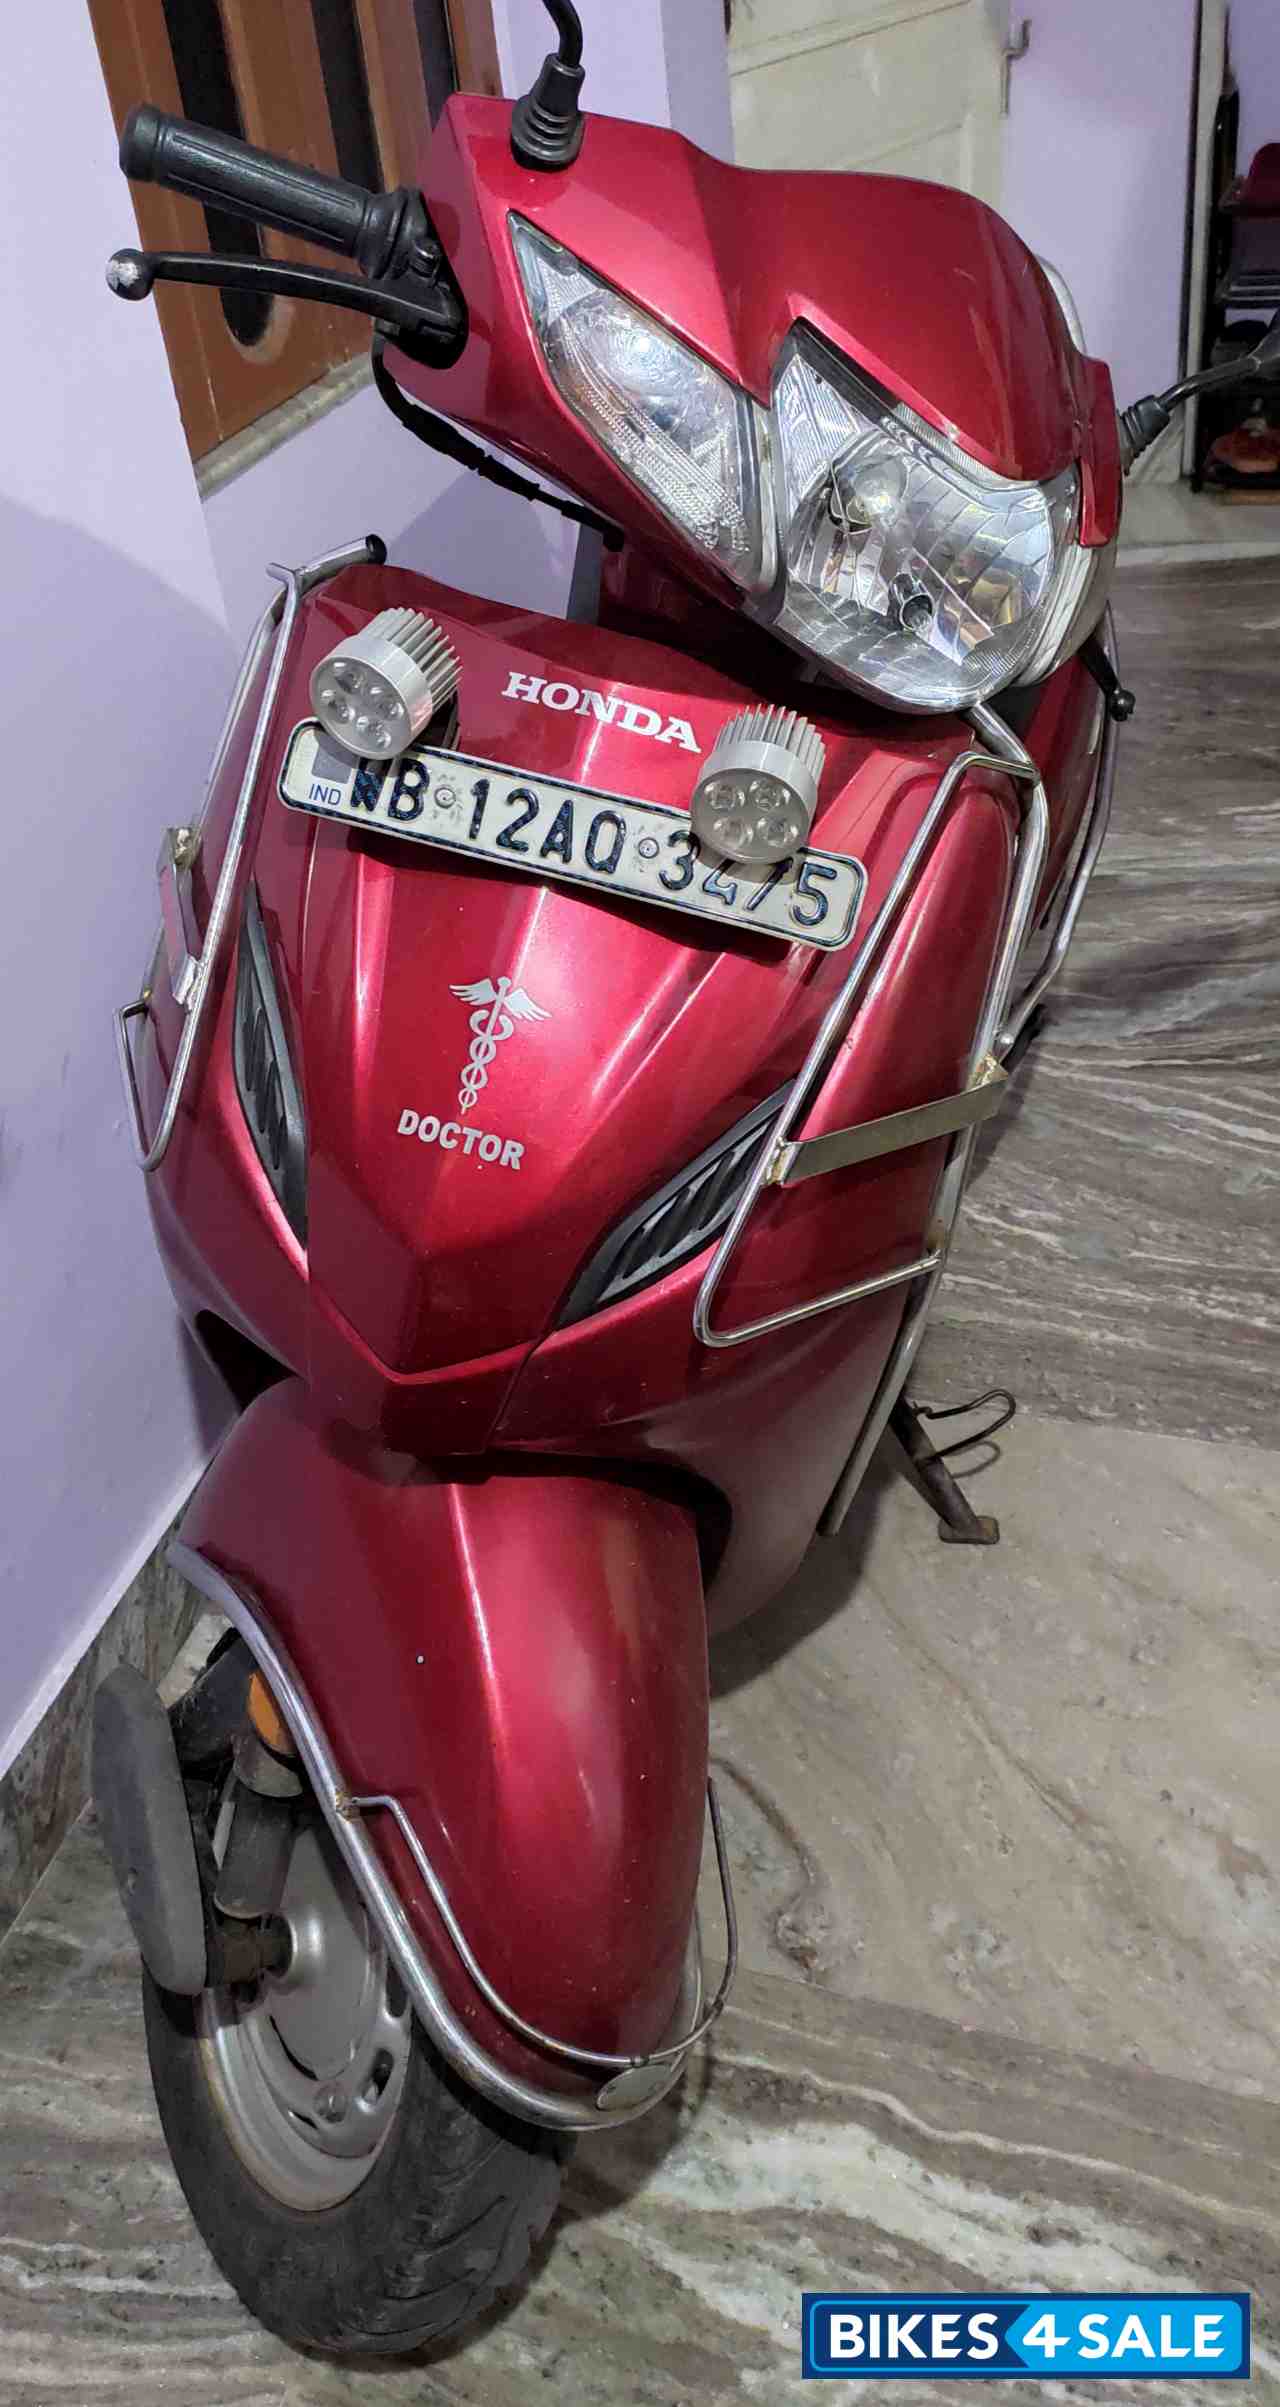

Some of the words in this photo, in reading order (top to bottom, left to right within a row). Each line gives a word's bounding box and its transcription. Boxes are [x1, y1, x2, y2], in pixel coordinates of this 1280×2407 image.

[501, 671, 701, 753] HONDA
[308, 783, 342, 806] IND
[350, 757, 431, 821] WB
[398, 1109, 525, 1169] DOCTOR
